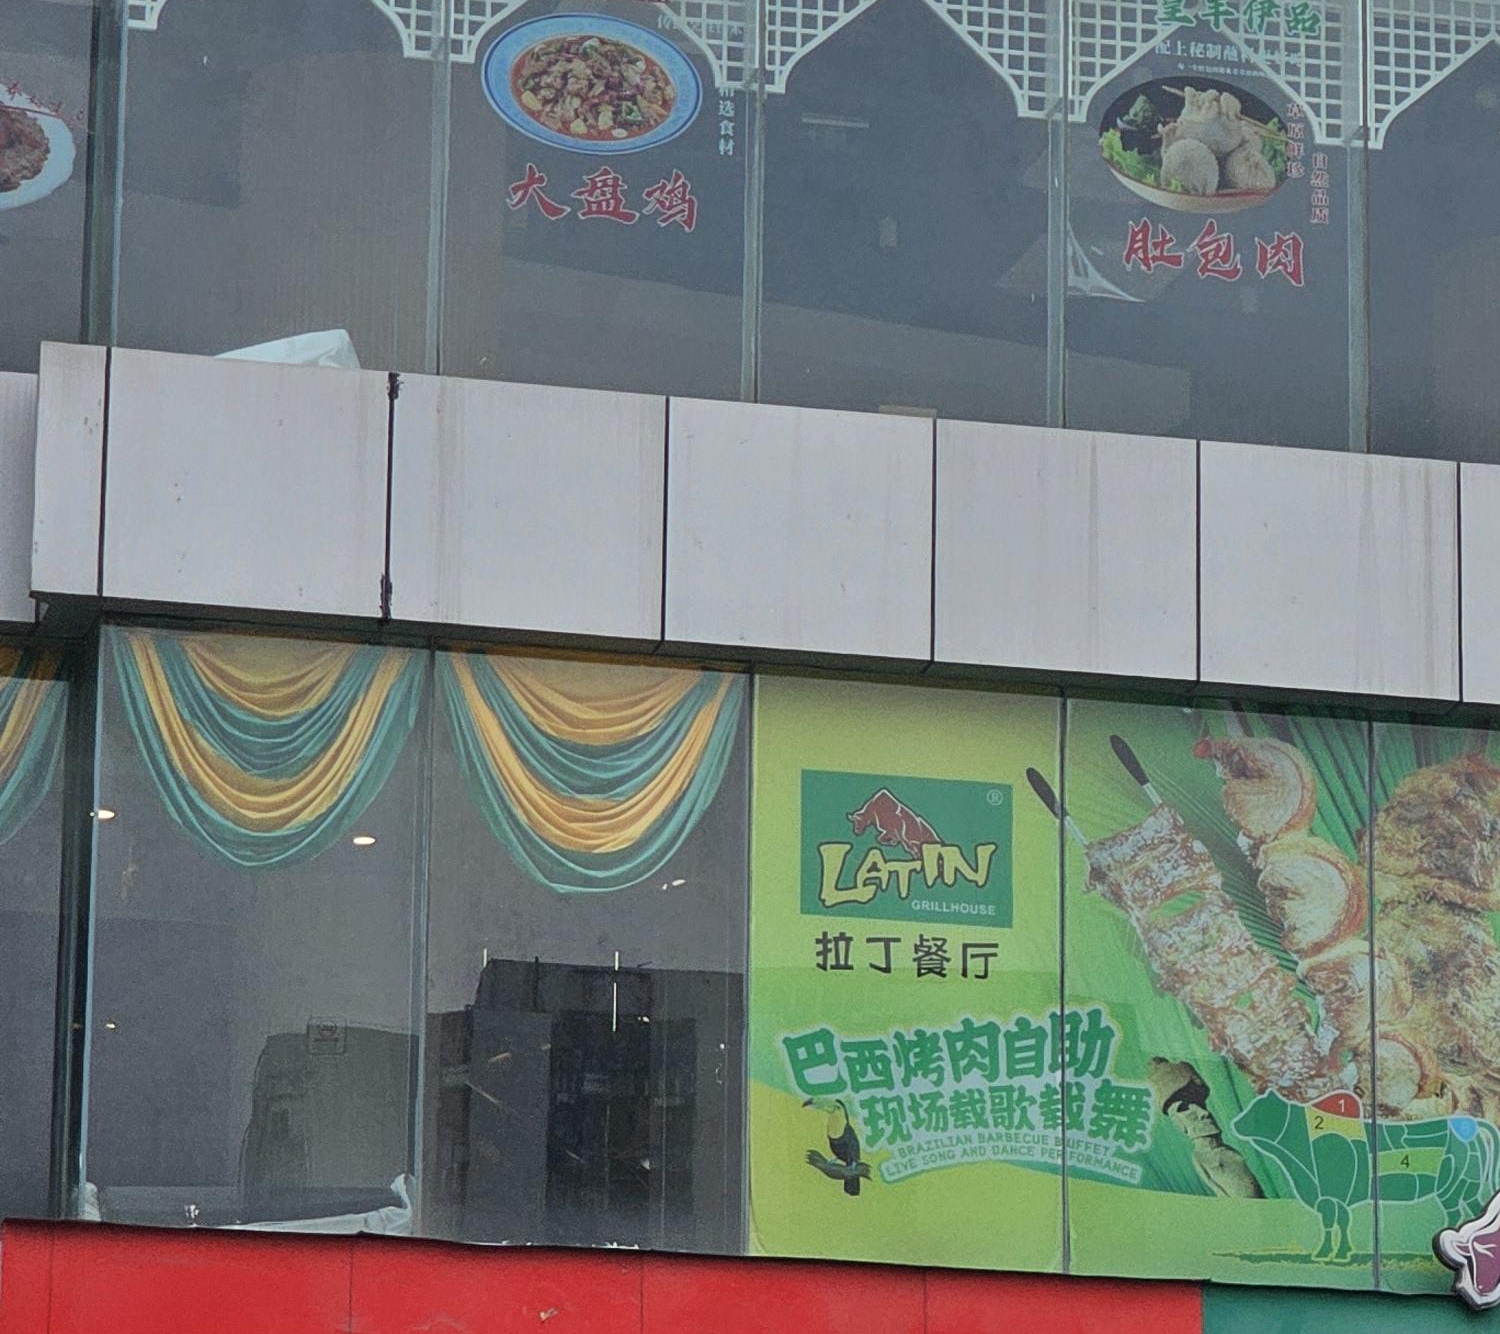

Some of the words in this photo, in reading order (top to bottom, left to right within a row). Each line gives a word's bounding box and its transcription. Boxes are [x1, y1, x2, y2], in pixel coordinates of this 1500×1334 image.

[506, 163, 698, 234] 大盘鸡
[1122, 217, 1305, 287] 肚包肉
[817, 841, 999, 908] LATIN
[911, 899, 997, 916] GRILLHOUSE
[814, 931, 1000, 980] 拉丁餐厅
[781, 1008, 1117, 1097] 巴西烤肉自助
[1314, 1115, 1325, 1130] 2
[886, 1157, 919, 1177] LIVE
[921, 1148, 957, 1166] SONG
[961, 1145, 987, 1158] AND
[991, 1144, 1035, 1157] DANCE
[1039, 1147, 1140, 1180] PERFORMANCE
[899, 1135, 973, 1159] BRAZILIAN
[977, 1131, 1050, 1146] BARBECUE
[1054, 1136, 1111, 1157] BUFFET
[1400, 1154, 1411, 1168] 4
